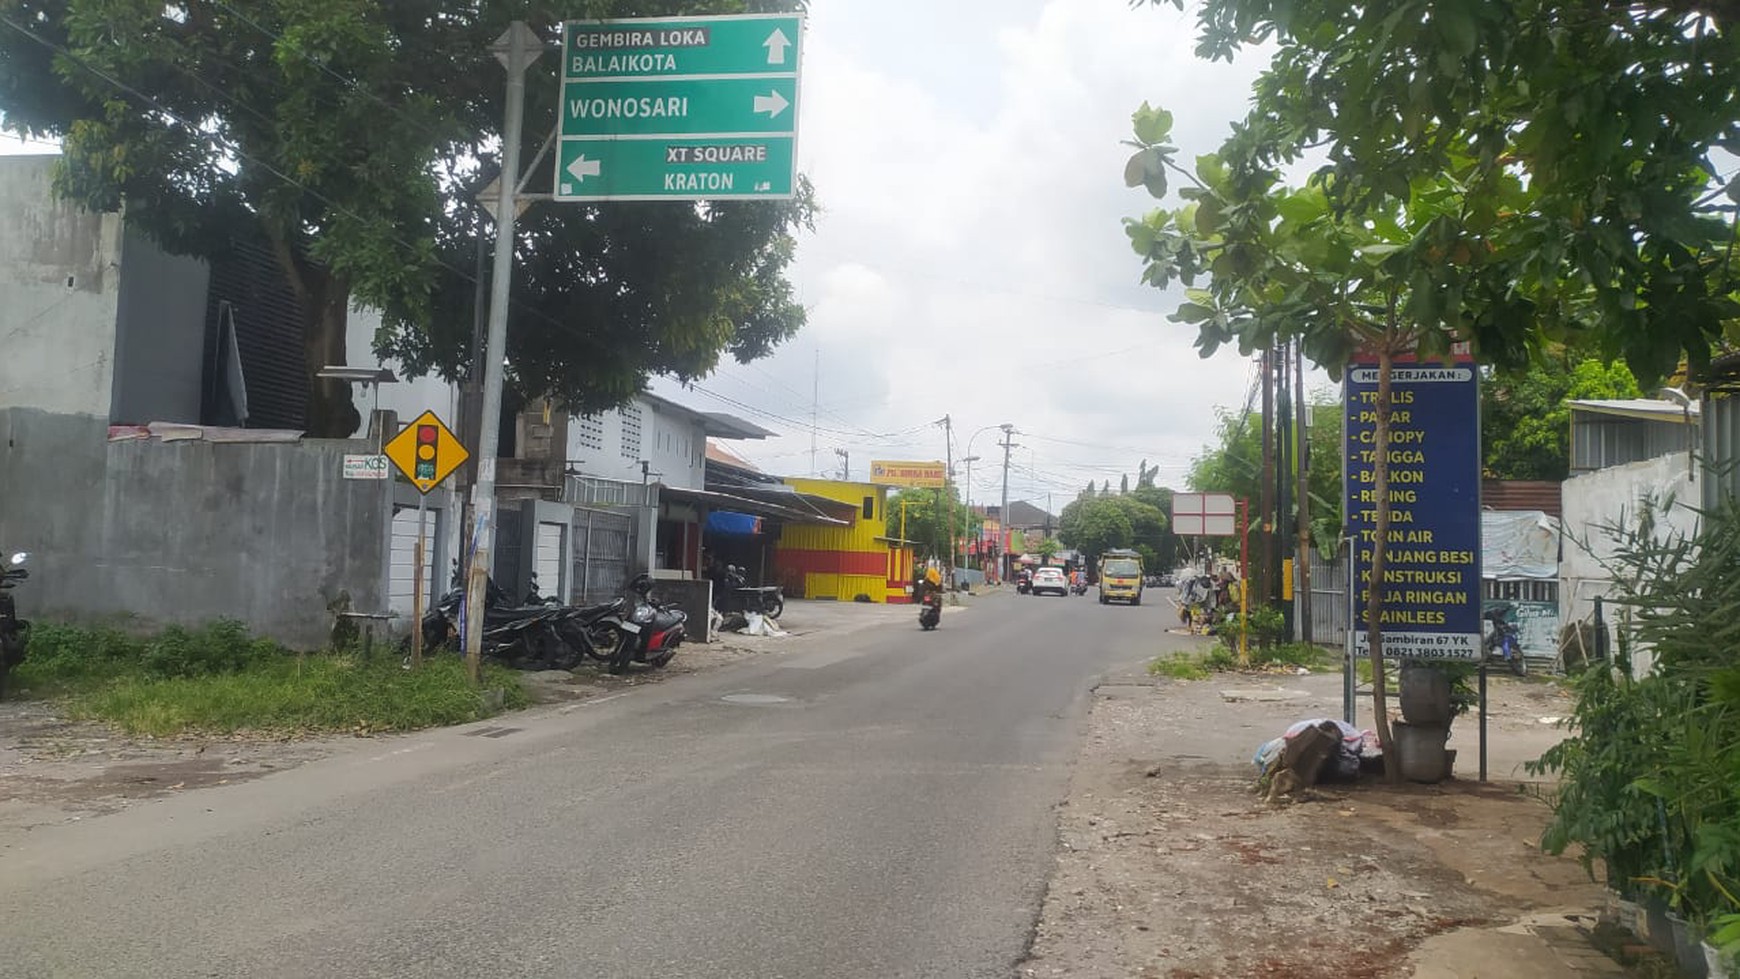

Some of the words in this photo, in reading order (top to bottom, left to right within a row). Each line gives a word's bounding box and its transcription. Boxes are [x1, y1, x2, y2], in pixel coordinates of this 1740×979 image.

[576, 32, 654, 48] GEMBIRA
[660, 30, 706, 46] LOKA
[572, 54, 677, 73] BALAIKOTA
[570, 97, 688, 118] WONOSARI
[667, 147, 689, 163] XT
[693, 146, 766, 163] SQUARE
[664, 173, 734, 191] KRATON
[1360, 391, 1414, 404] TRLIS
[1360, 411, 1411, 423] PAAR
[364, 457, 387, 470] KOS
[1360, 470, 1424, 483] BAKON
[1360, 490, 1417, 502] REING
[1360, 510, 1413, 523] TEDA
[1407, 531, 1433, 543] AIR
[1440, 551, 1474, 564] BESI
[1361, 570, 1462, 583] KNSTRUKSI
[1362, 591, 1403, 603] BJA
[1406, 591, 1467, 604] RINGAN
[1361, 611, 1446, 624] SAINLEES
[1436, 636, 1449, 646] 67
[1452, 636, 1469, 646] YK
